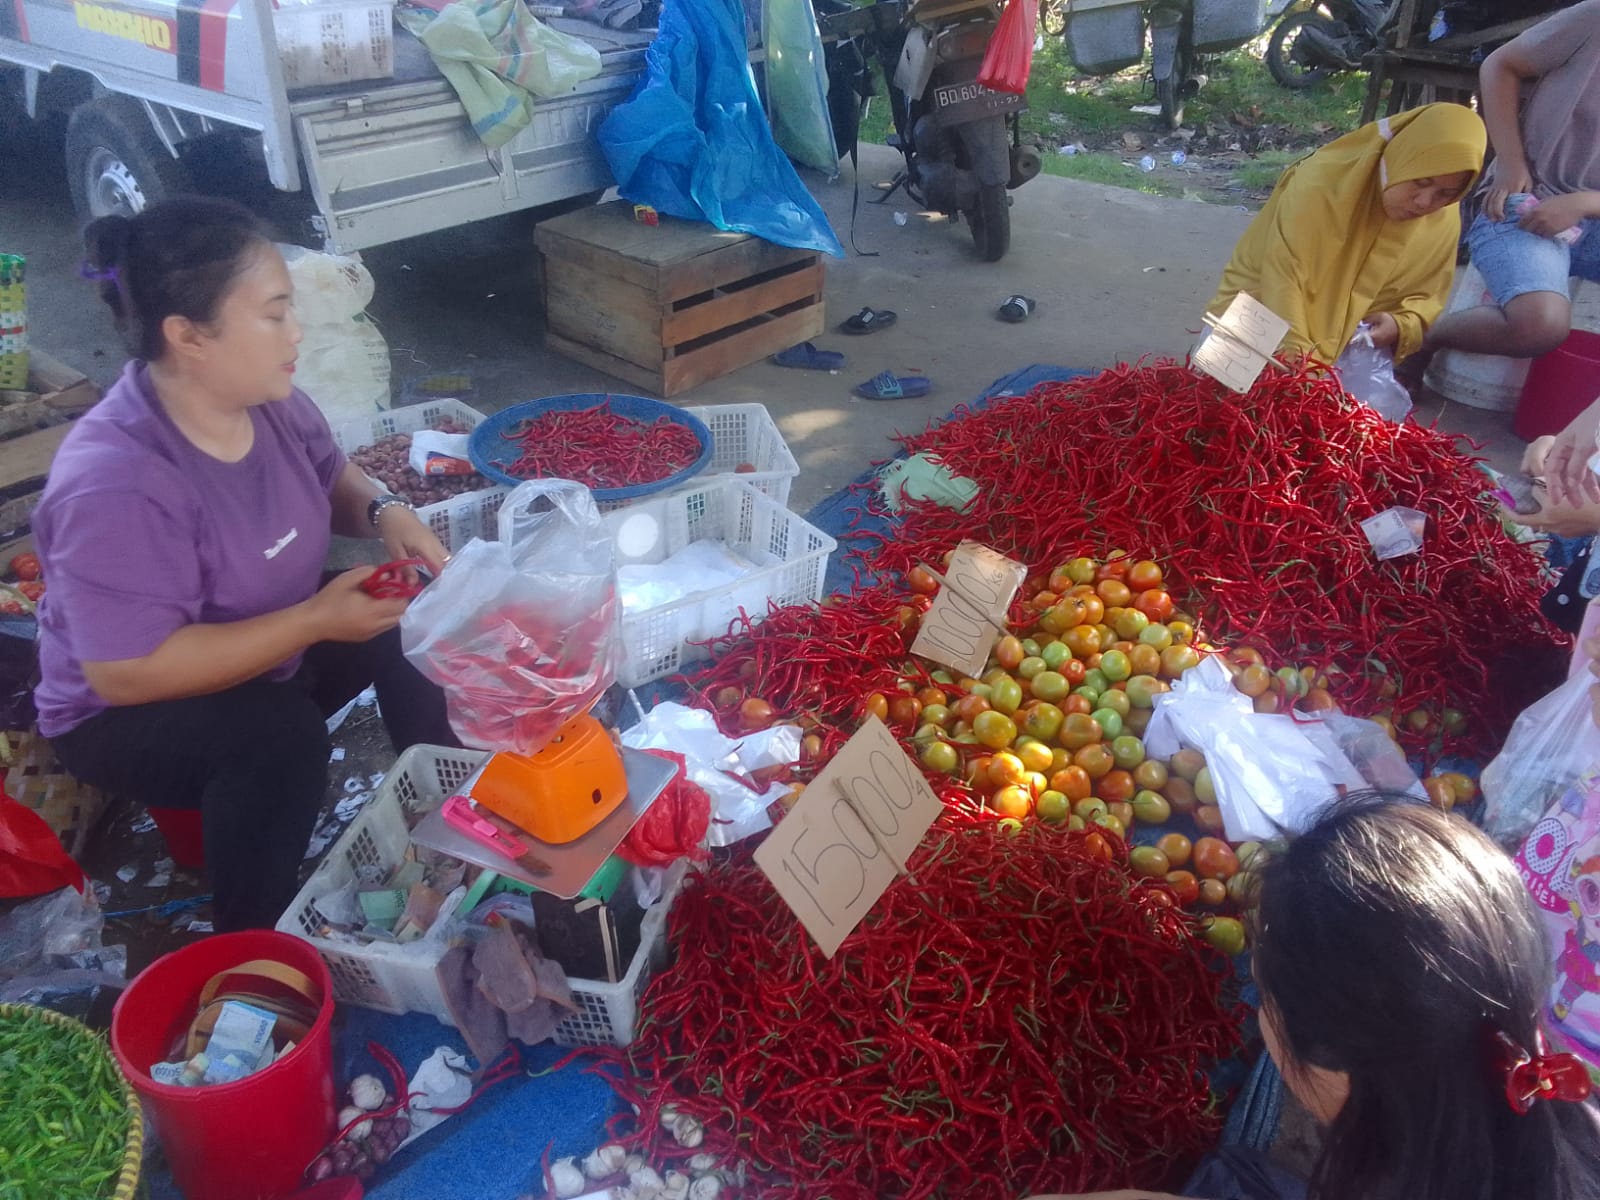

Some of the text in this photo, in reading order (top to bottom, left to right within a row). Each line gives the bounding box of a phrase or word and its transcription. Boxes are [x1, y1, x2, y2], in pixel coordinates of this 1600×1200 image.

[939, 89, 958, 107] BD
[922, 572, 998, 664] 10000
[782, 749, 914, 927] 15000
